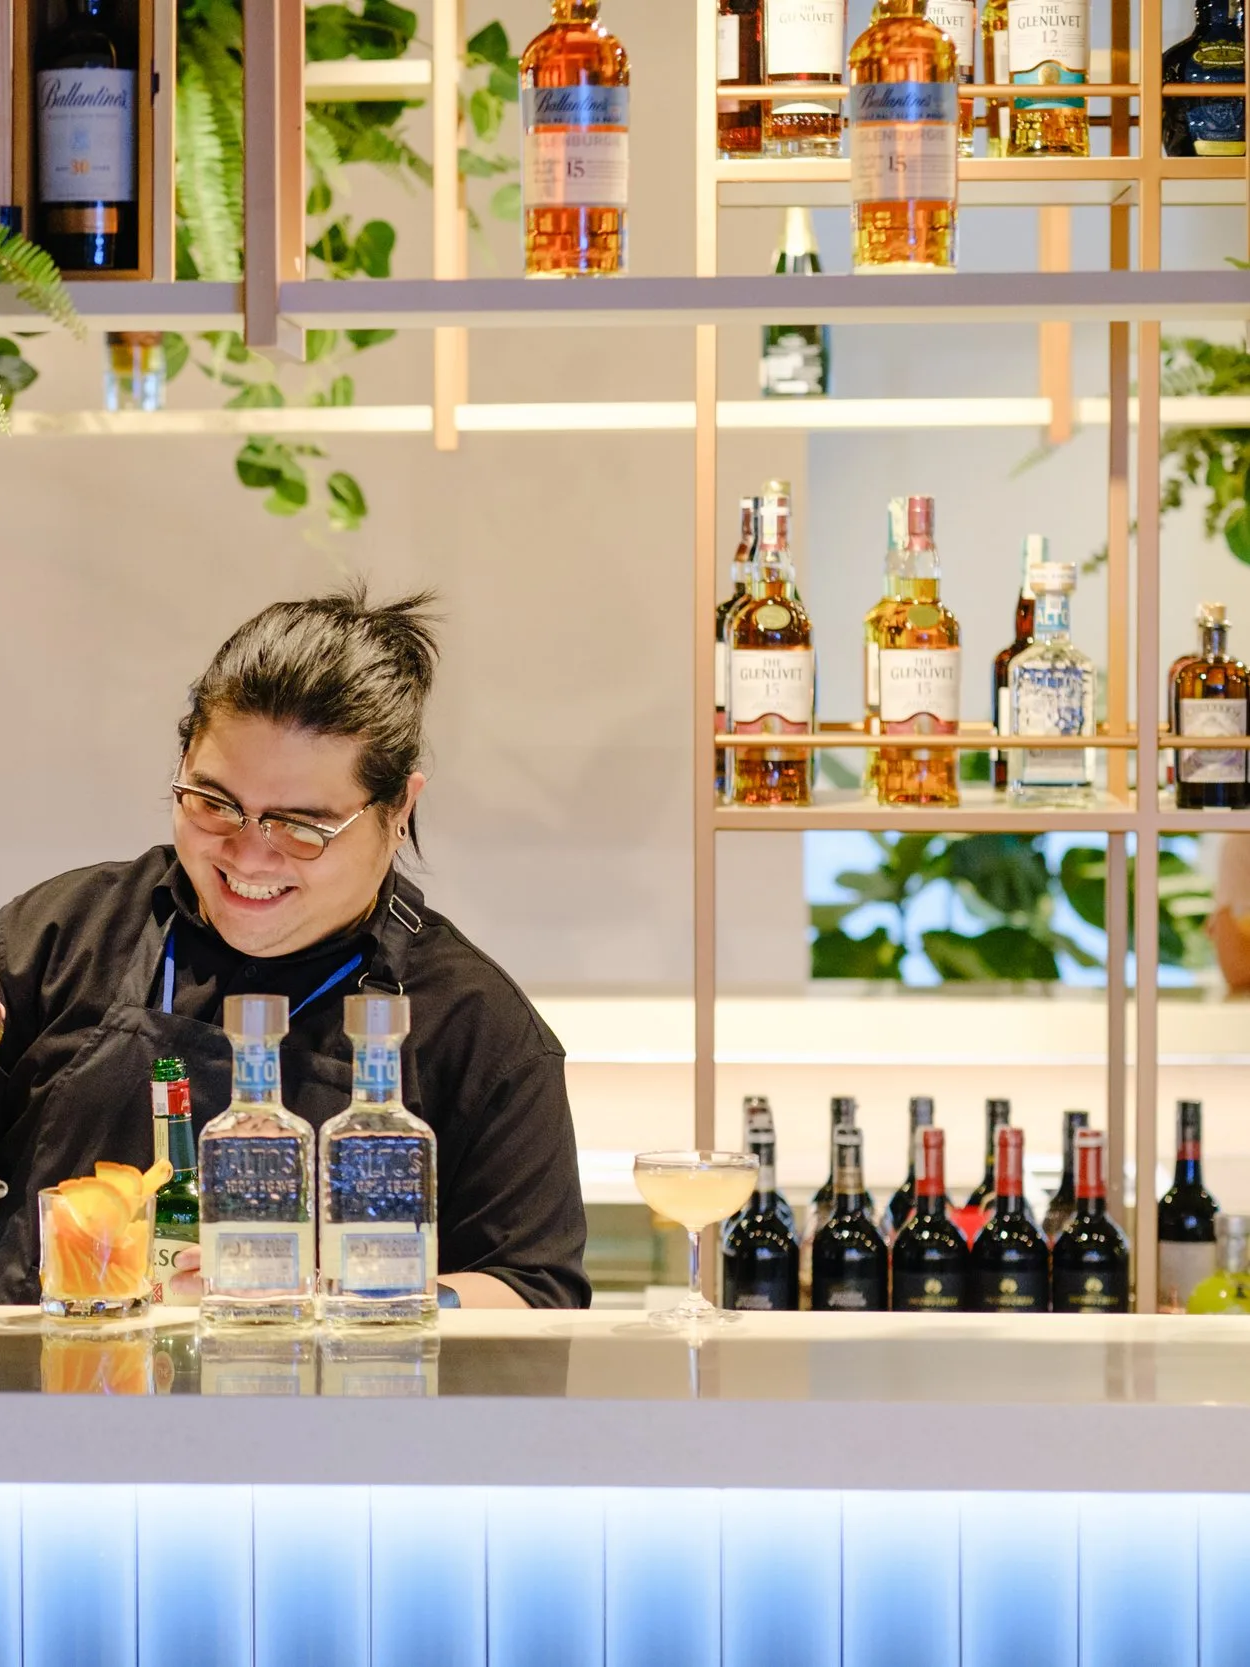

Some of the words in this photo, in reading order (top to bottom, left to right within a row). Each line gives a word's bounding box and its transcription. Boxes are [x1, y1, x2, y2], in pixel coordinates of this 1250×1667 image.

[929, 7, 945, 15] THE
[1040, 5, 1059, 13] THE
[779, 13, 834, 24] GLENLIVET
[928, 15, 965, 27] NLIVET
[1017, 15, 1081, 29] GLENLIVET
[1043, 29, 1058, 44] 12
[567, 160, 586, 178] 15
[889, 155, 907, 172] 15
[763, 658, 781, 667] THE
[915, 657, 932, 666] THE
[740, 668, 802, 681] GLENLIVET
[891, 667, 954, 680] GLENLIVET
[766, 682, 780, 697] 15
[917, 682, 932, 695] 15
